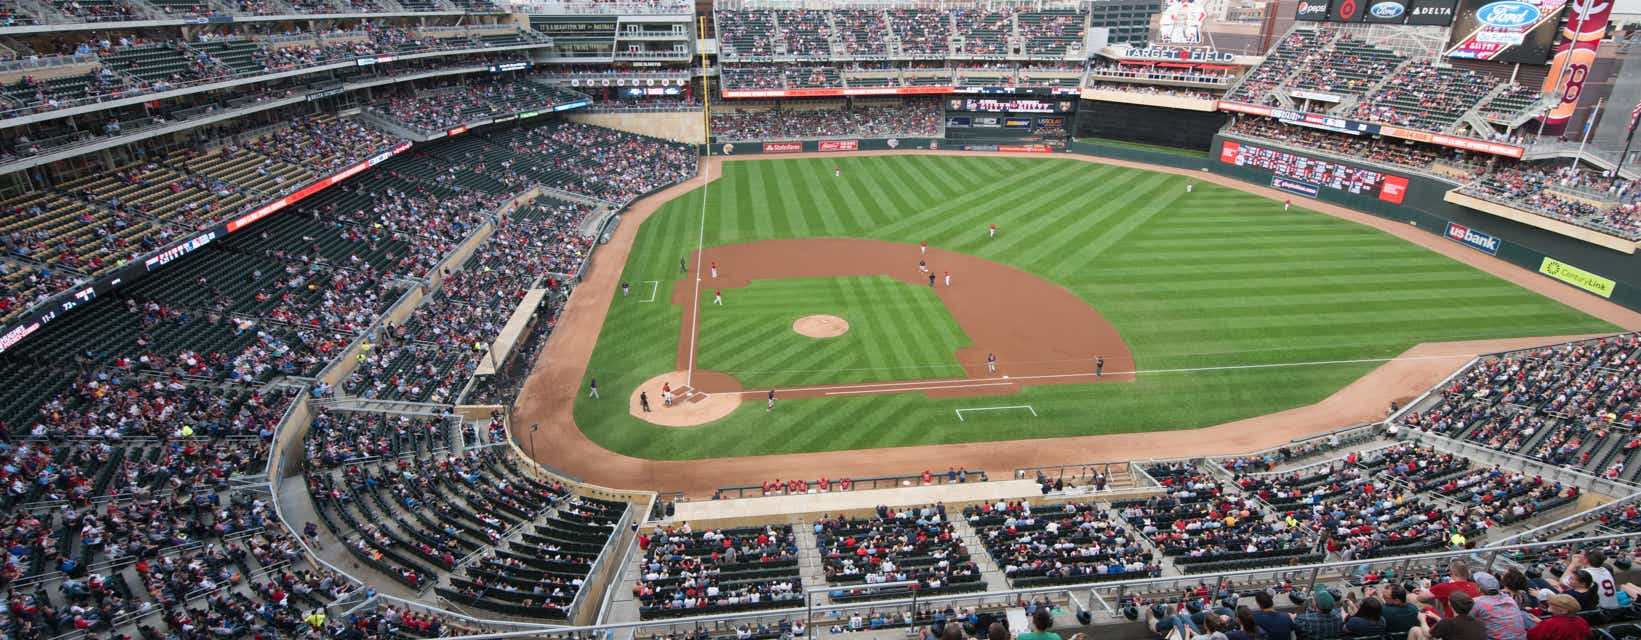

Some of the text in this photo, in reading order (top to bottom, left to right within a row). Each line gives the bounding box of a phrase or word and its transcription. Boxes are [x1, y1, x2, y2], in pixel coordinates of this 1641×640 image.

[1375, 6, 1397, 16] Ford
[1420, 7, 1451, 15] DELTA
[1486, 4, 1530, 22] Ford
[1125, 47, 1233, 62] TARGET FIELD
[1561, 268, 1607, 291] CenturyLink
[1602, 579, 1615, 597] 9
